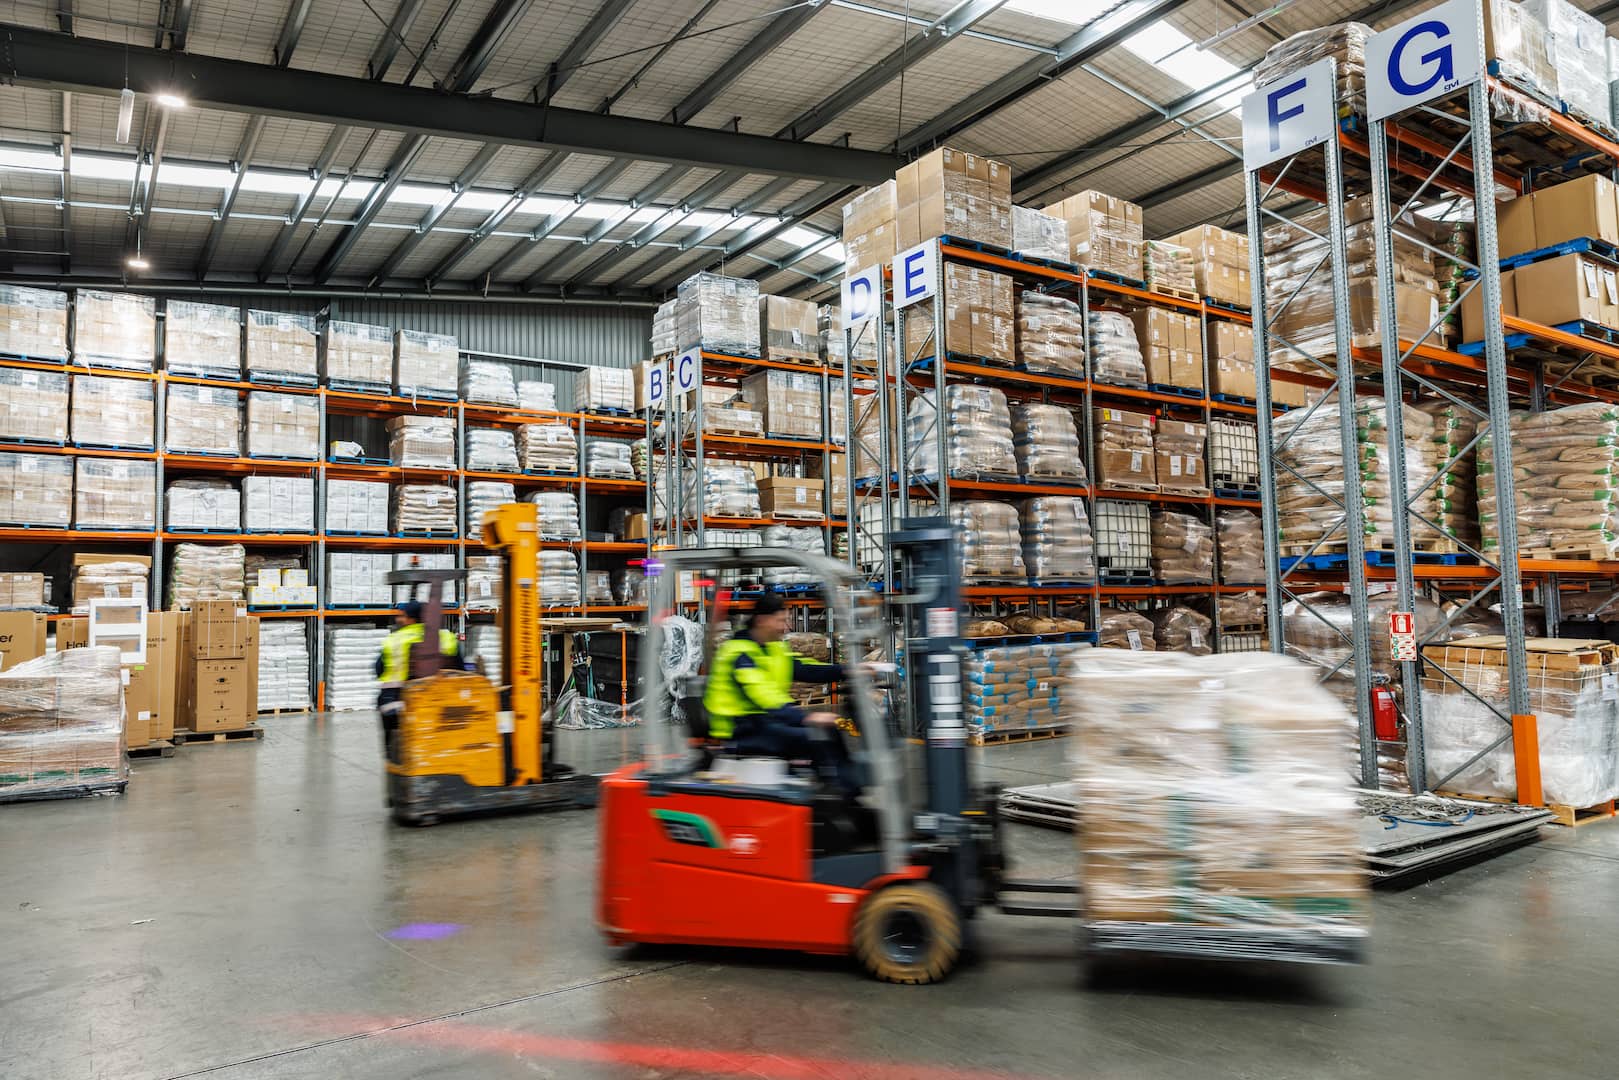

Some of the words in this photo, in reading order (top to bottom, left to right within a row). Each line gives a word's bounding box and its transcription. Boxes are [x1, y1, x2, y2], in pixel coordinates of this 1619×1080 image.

[1387, 20, 1454, 96] G
[1267, 77, 1307, 152] F
[904, 249, 926, 299] E
[849, 276, 872, 320] D
[649, 368, 663, 401] B
[678, 354, 693, 389] C
